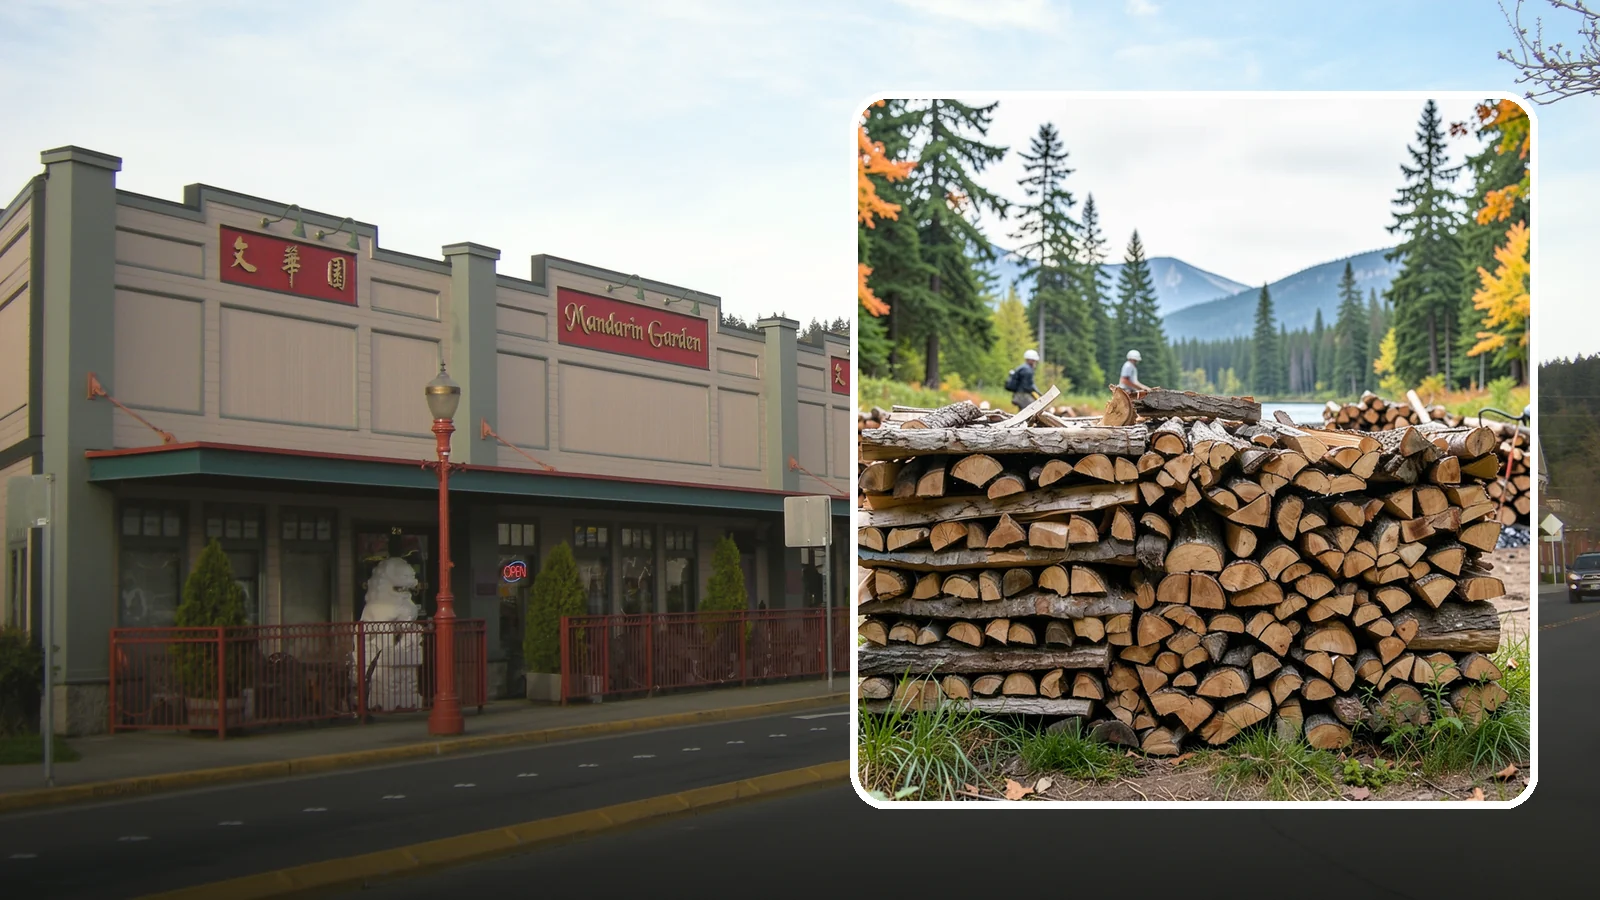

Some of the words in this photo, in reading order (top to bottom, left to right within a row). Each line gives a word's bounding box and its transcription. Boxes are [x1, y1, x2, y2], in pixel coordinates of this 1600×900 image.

[231, 236, 346, 291] 文華園
[565, 302, 643, 341] Mandarin
[648, 320, 702, 352] Garden
[504, 566, 527, 578] OPEN
